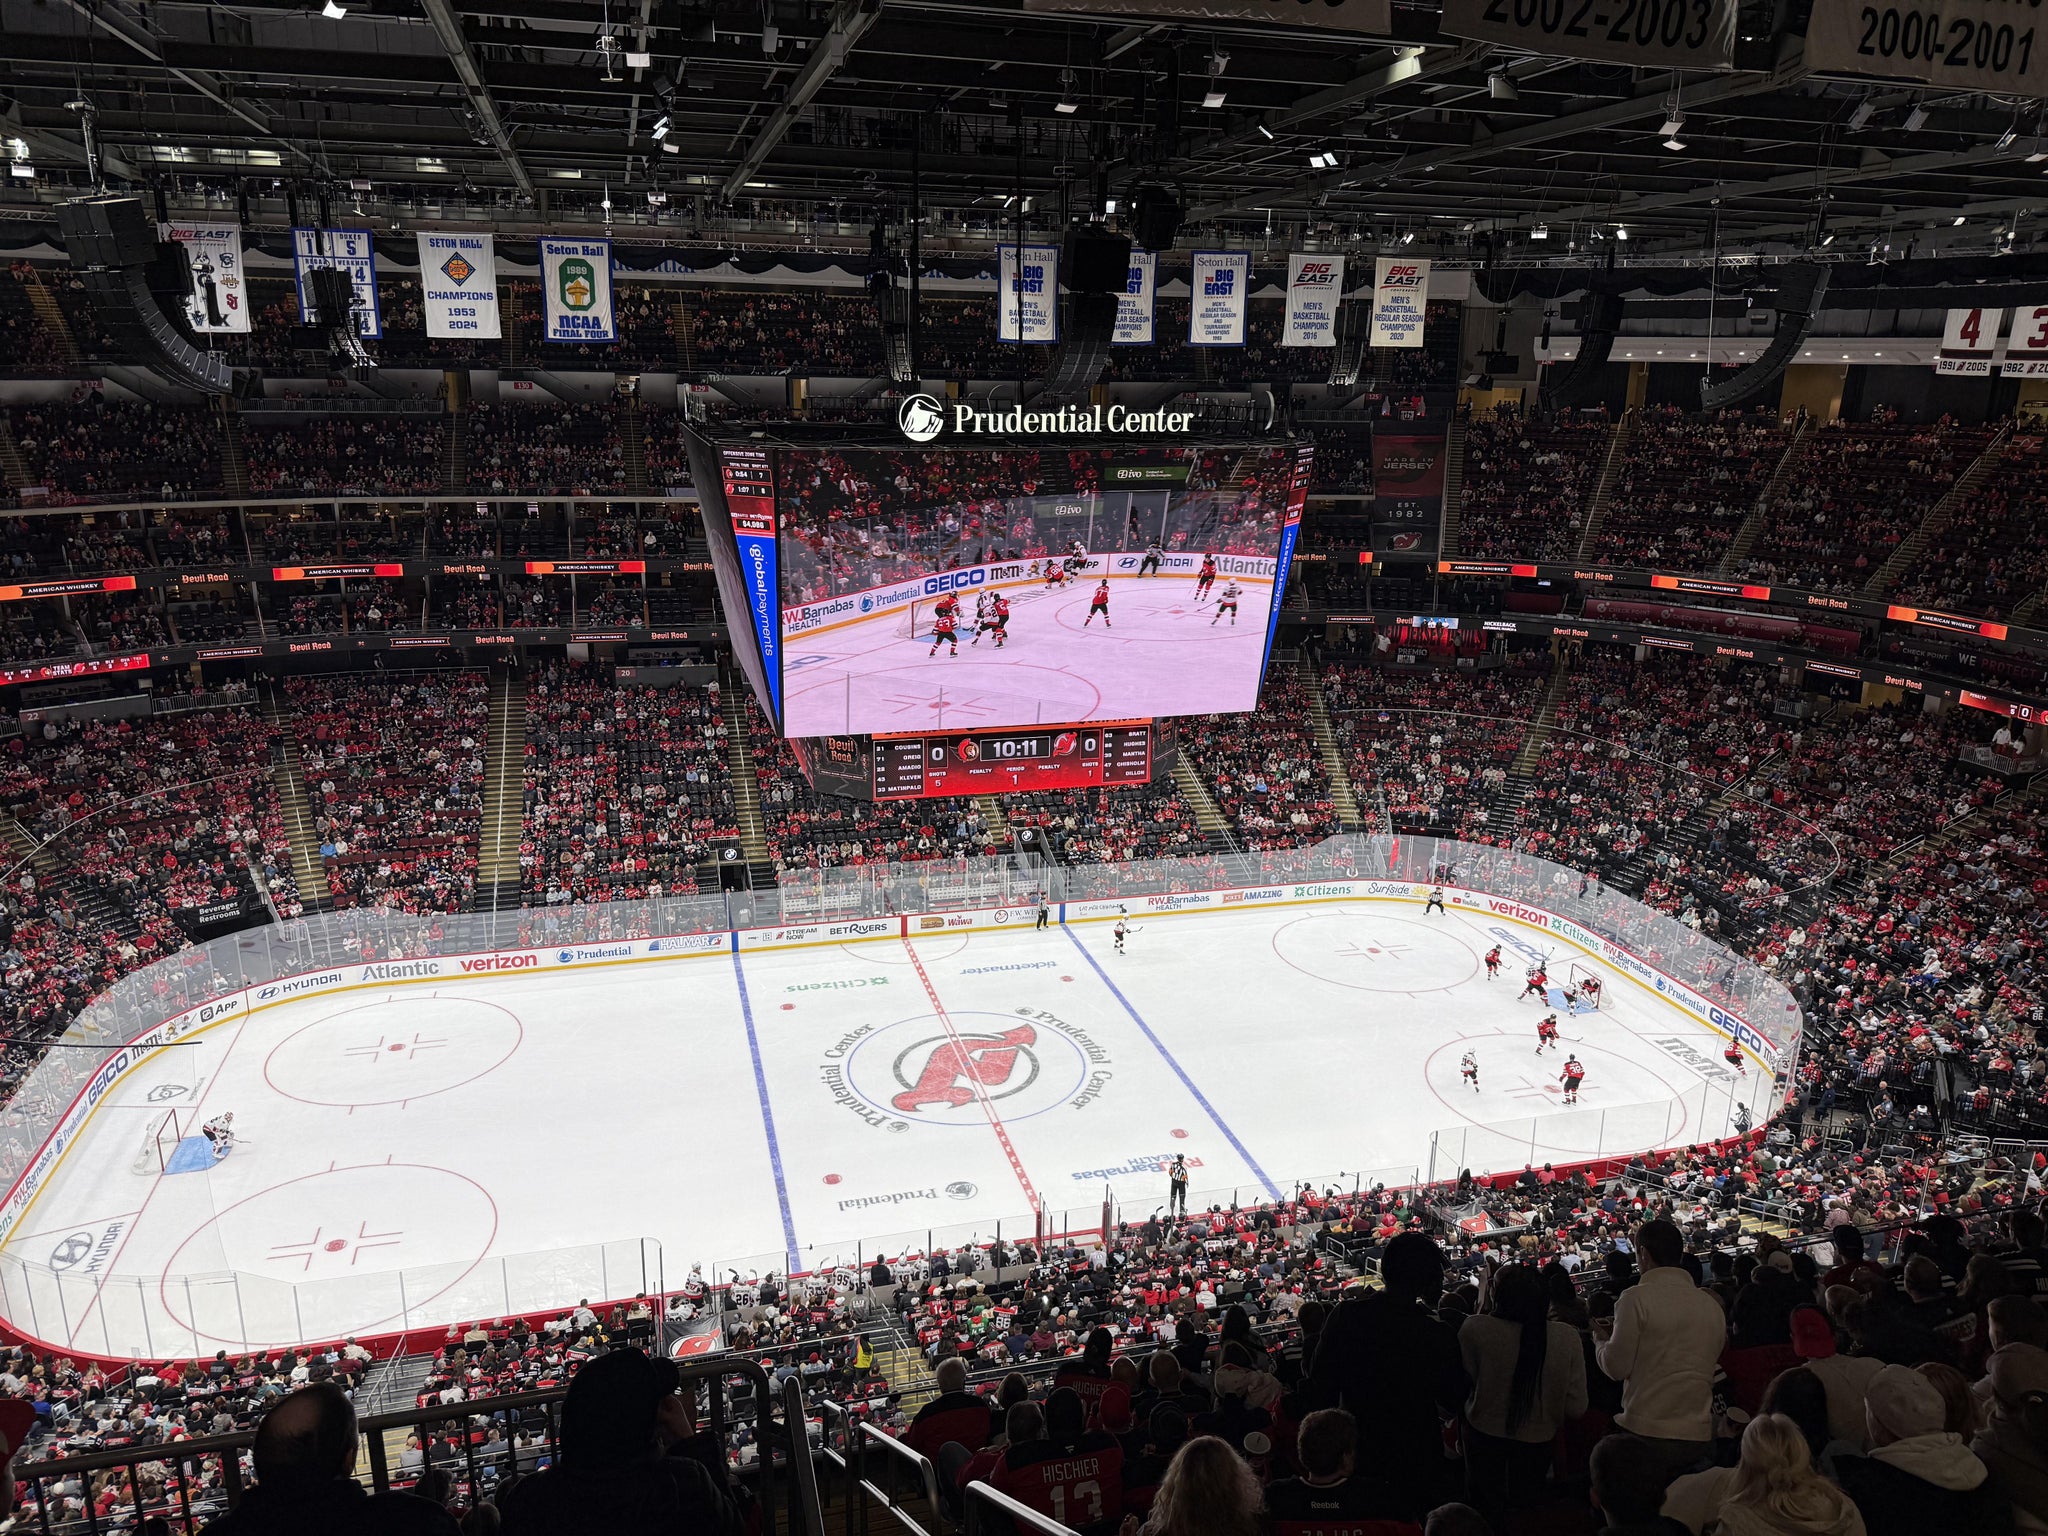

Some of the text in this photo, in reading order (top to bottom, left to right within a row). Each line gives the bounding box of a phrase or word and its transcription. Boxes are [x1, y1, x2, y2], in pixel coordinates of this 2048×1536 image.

[1857, 7, 2036, 75] 2000-2001
[193, 230, 233, 239] EAST
[346, 240, 356, 255] 5
[429, 238, 482, 249] SETON HALL
[547, 244, 604, 257] Seton Hall
[1034, 252, 1053, 262] Hall
[1134, 256, 1152, 264] Hall
[1197, 257, 1243, 267] Seton Hall
[566, 266, 587, 275] 1989
[1023, 266, 1043, 279] BIG
[1302, 263, 1331, 274] BIG
[1388, 265, 1418, 276] BIG
[1215, 269, 1234, 282] BIG
[1296, 273, 1338, 283] EAST
[1383, 276, 1423, 285] EAST
[1204, 282, 1234, 295] EAST
[427, 291, 494, 301] CHAMPIONS
[1390, 296, 1410, 304] MEN'S
[1303, 302, 1322, 310] MEN'S
[1381, 305, 1418, 313] BASKETBALL
[448, 307, 476, 317] 1953
[1293, 311, 1330, 320] BASKETBALL
[1374, 313, 1424, 322] REGULAR SEASON
[1128, 315, 1150, 323] SEASON
[448, 320, 477, 330] 2024
[1293, 321, 1328, 330] CHAMPIONS
[1380, 323, 1415, 331] CHAMPIONS
[1960, 308, 1982, 348] 4
[2027, 308, 2048, 348] 3
[553, 329, 609, 339] FINAL FOUR
[1302, 332, 1317, 340] 2016
[1389, 332, 1404, 340] 2020
[1939, 361, 1988, 371] 1991 2005
[2003, 363, 2024, 373] 1982
[953, 404, 1195, 433] Prudential Center
[1388, 510, 1423, 518] 1982
[343, 566, 370, 574] WHISKEY
[1213, 555, 1277, 576] Atlantic
[181, 574, 205, 584] Devil
[1573, 570, 1594, 580] Devil
[924, 568, 985, 595] GEICO
[27, 583, 99, 594] AMERICAN WHISKEY
[1681, 582, 1739, 593] AMERICAN WHISKEY
[749, 543, 773, 656] globalpayments
[876, 586, 920, 607] Prudential
[1808, 596, 1827, 607] Devil
[789, 617, 822, 633] HEALTH
[1920, 614, 1977, 630] AMERICAN WHISKEY
[475, 635, 495, 644] Devil
[290, 643, 312, 653] Devil
[1398, 647, 1428, 656] PREMIO
[1716, 646, 1735, 656] Devil
[1902, 647, 1949, 660] CHECK POINT
[53, 665, 71, 673] TEAM
[1958, 653, 2038, 679] WE PROTECT
[53, 669, 73, 677] STATS
[1885, 675, 1904, 687] Devil
[1969, 692, 1987, 701] PENALTY
[2020, 707, 2030, 718] 0
[993, 740, 1038, 758] 10:11
[1085, 738, 1096, 752] 0
[931, 746, 944, 761] 0
[969, 767, 992, 775] PENALTY
[1012, 774, 1018, 784] 1
[887, 784, 921, 792] MATINPALO
[1243, 889, 1282, 900] AMAZING
[1306, 884, 1353, 896] Citizens
[1368, 882, 1410, 897] Surfside
[199, 900, 238, 916] Beverages
[1155, 903, 1182, 911] HEALTH
[199, 908, 241, 924] Restrooms
[948, 918, 973, 927] Wawa
[1488, 899, 1600, 951] verizon Citizens
[786, 927, 818, 935] STREAM
[1488, 926, 1549, 962] GEICO
[283, 936, 711, 993] HYUNDAI Atlantic verizon Prudential HALMAR
[959, 960, 1057, 976] ticketmaster
[1608, 954, 1629, 972] HEALTH
[787, 979, 867, 994] Citizens
[1667, 984, 1706, 1015] Prudential
[1709, 1007, 1761, 1053] GEICO
[1034, 1010, 1113, 1112] Prudential Center
[820, 1023, 888, 1128] Prudential Center
[62, 1105, 89, 1142] Prudential
[88, 1052, 129, 1106] GEICO
[21, 1181, 39, 1209] HEALTH
[838, 1186, 939, 1211] Prudential
[1306, 1193, 1317, 1202] 13
[84, 1222, 125, 1273] HYUNDAI
[837, 1274, 848, 1286] 95
[735, 1293, 749, 1306] 26
[1041, 1457, 1100, 1484] HISCHIER
[1049, 1479, 1103, 1524] 13
[1310, 1500, 1340, 1510] Reebok
